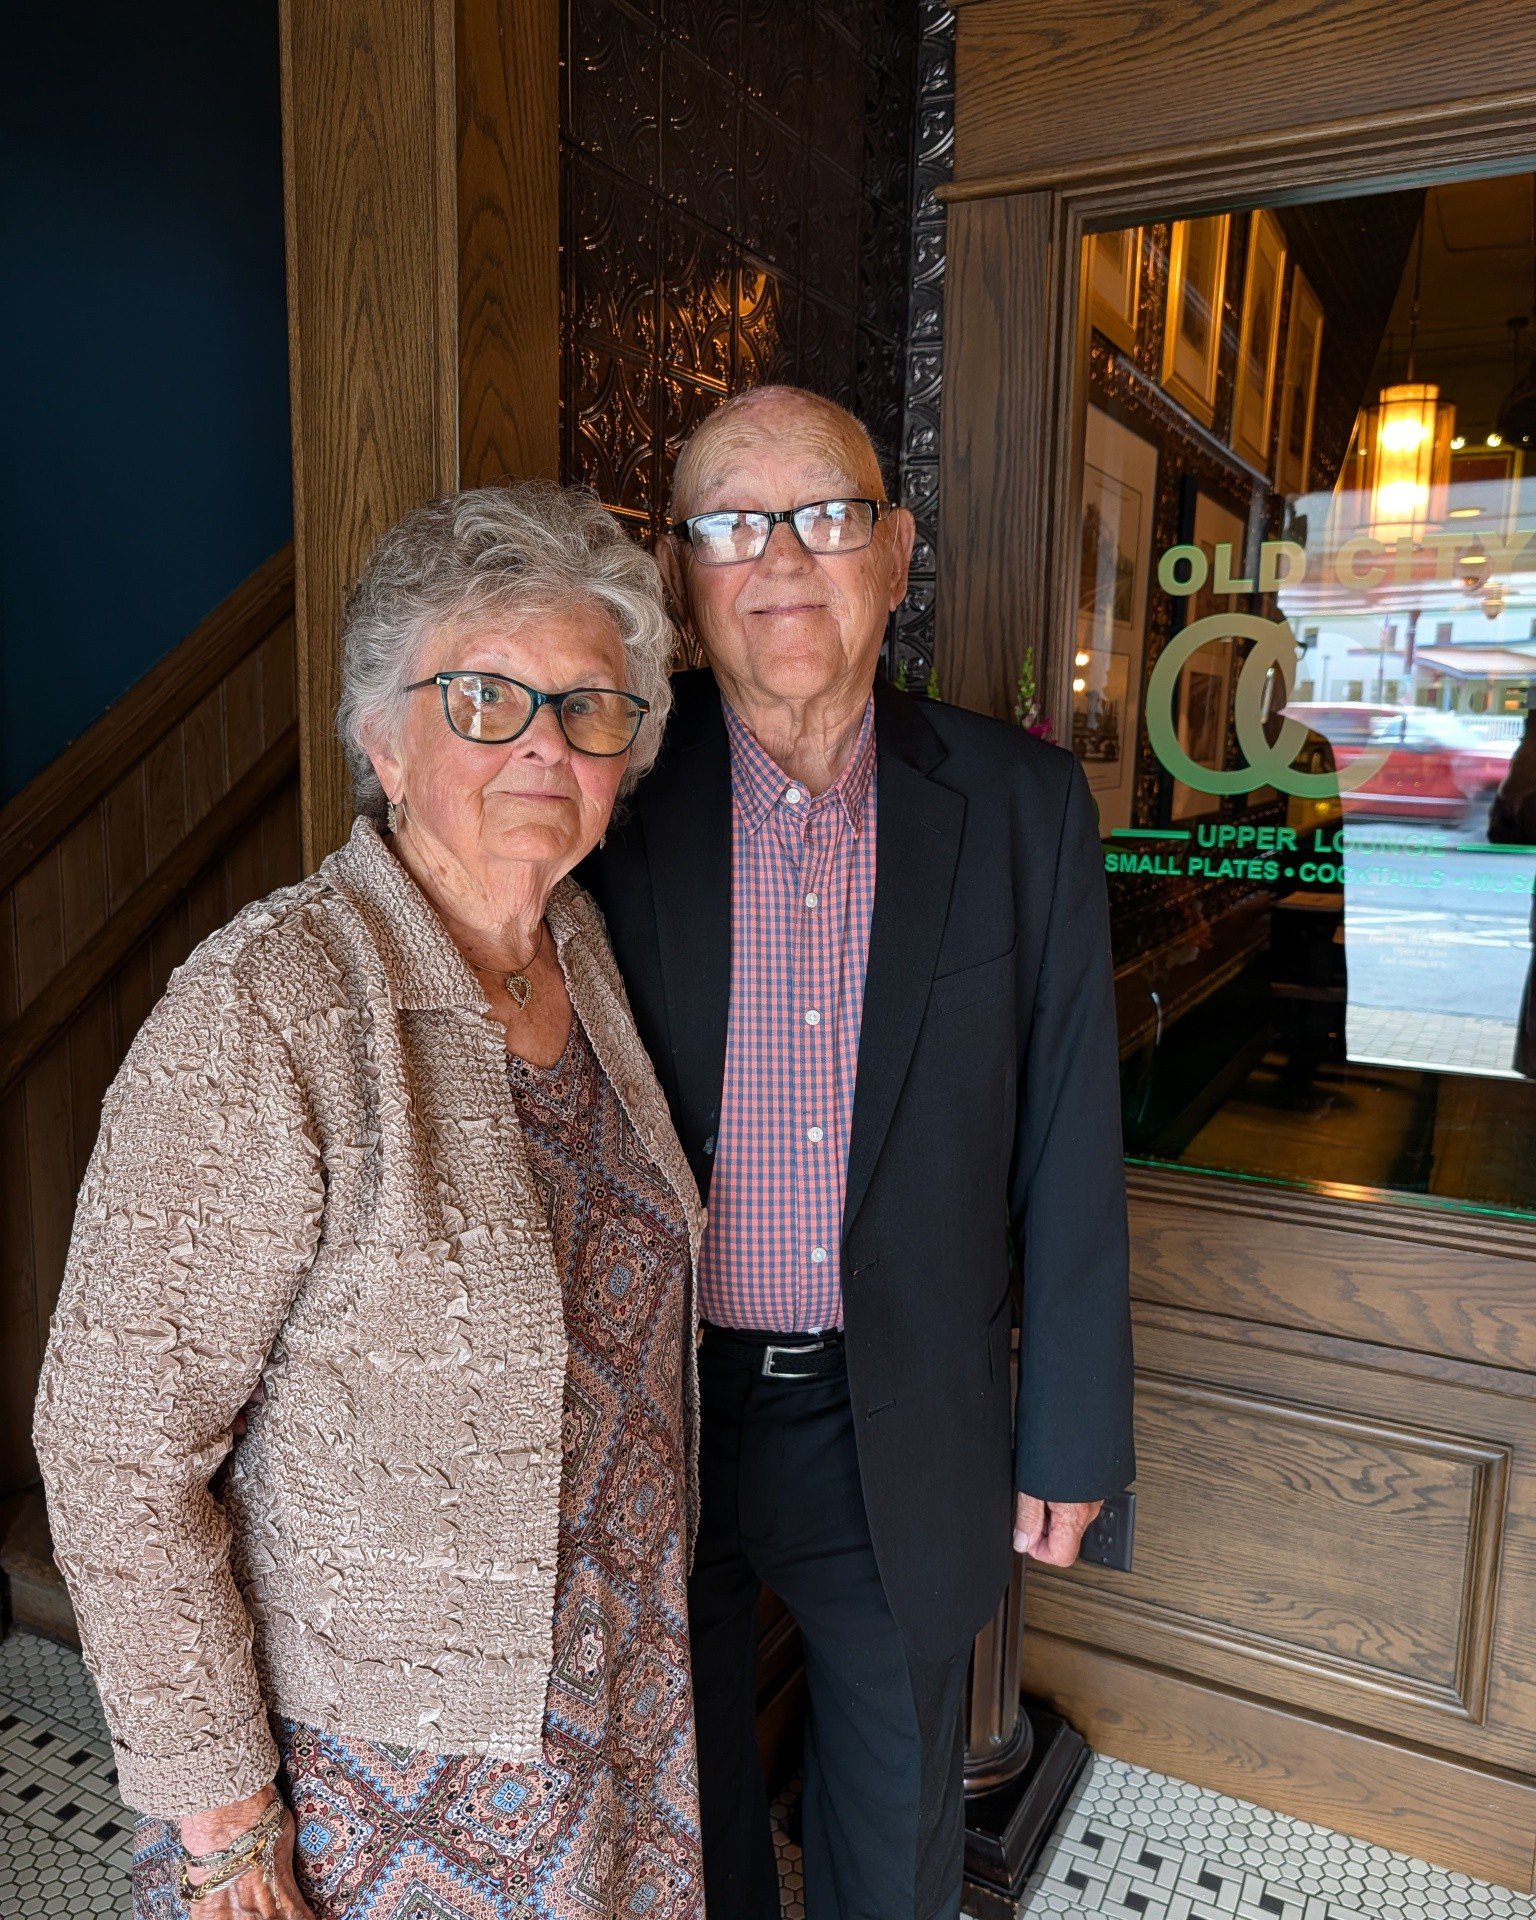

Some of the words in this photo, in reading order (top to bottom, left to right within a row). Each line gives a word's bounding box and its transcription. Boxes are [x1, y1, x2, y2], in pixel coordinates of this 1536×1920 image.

[1157, 540, 1307, 597] OLD
[1336, 529, 1536, 589] CITY
[1198, 824, 1298, 851] UPPER
[1314, 828, 1448, 858] LOUNGE
[1104, 853, 1183, 876] SMALL
[1188, 857, 1280, 881] PLATES
[1300, 862, 1446, 889] COCKTAILS
